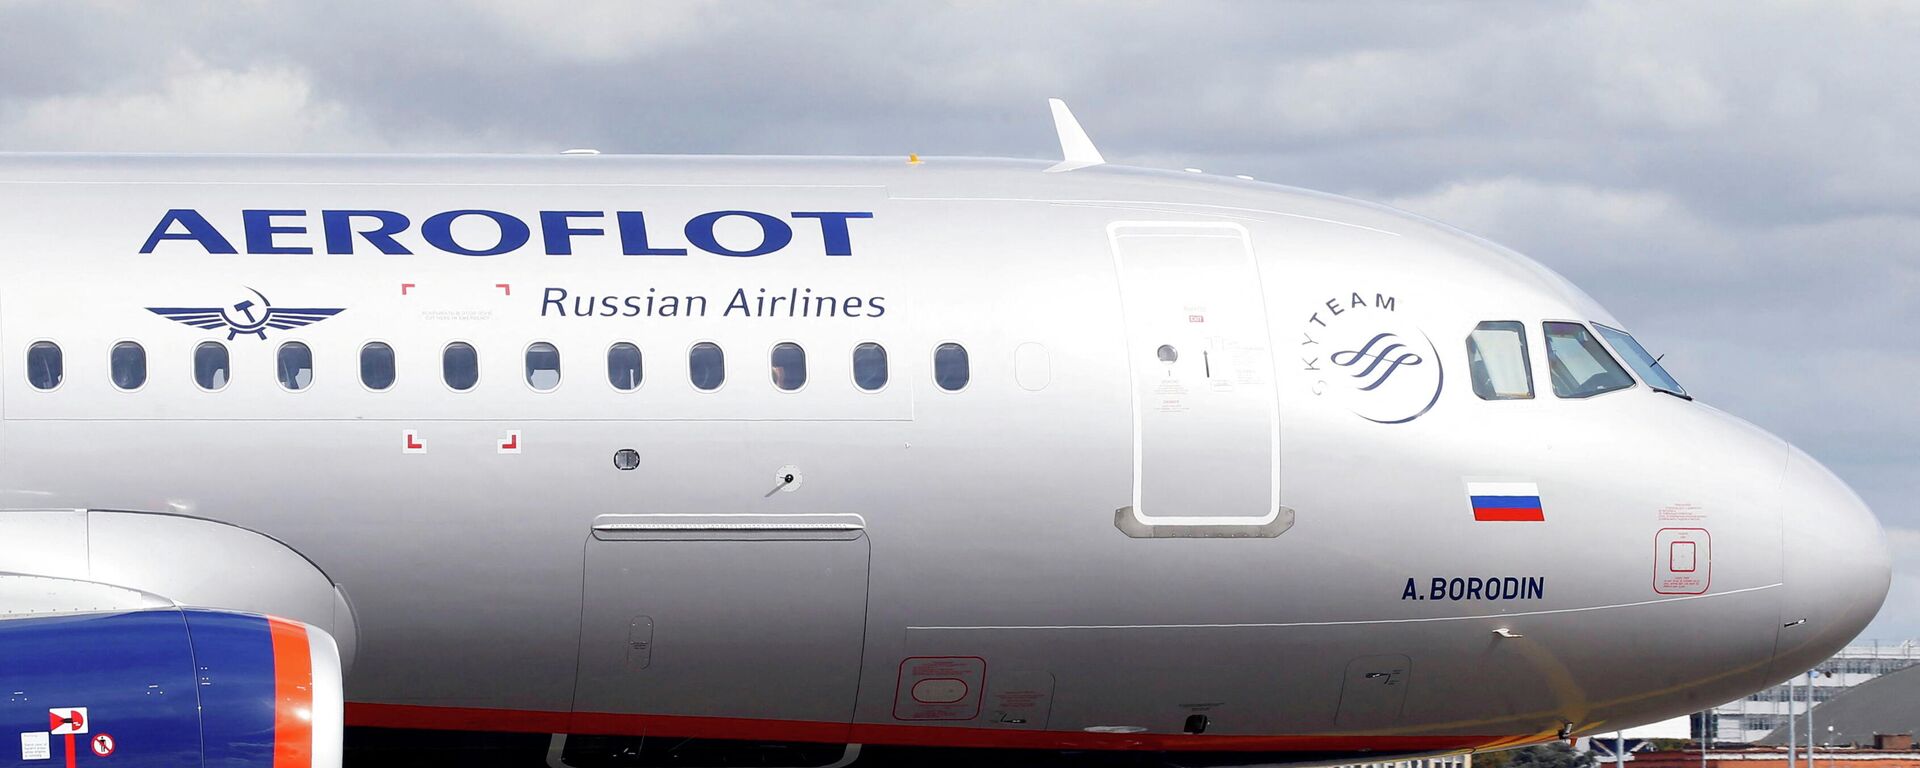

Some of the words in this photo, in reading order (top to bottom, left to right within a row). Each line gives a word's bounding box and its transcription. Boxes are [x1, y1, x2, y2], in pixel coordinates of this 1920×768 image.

[139, 209, 873, 257] AEROFLOT
[541, 287, 707, 318] Russian
[723, 287, 886, 318] Airlines
[1302, 291, 1396, 397] SKYTEAM
